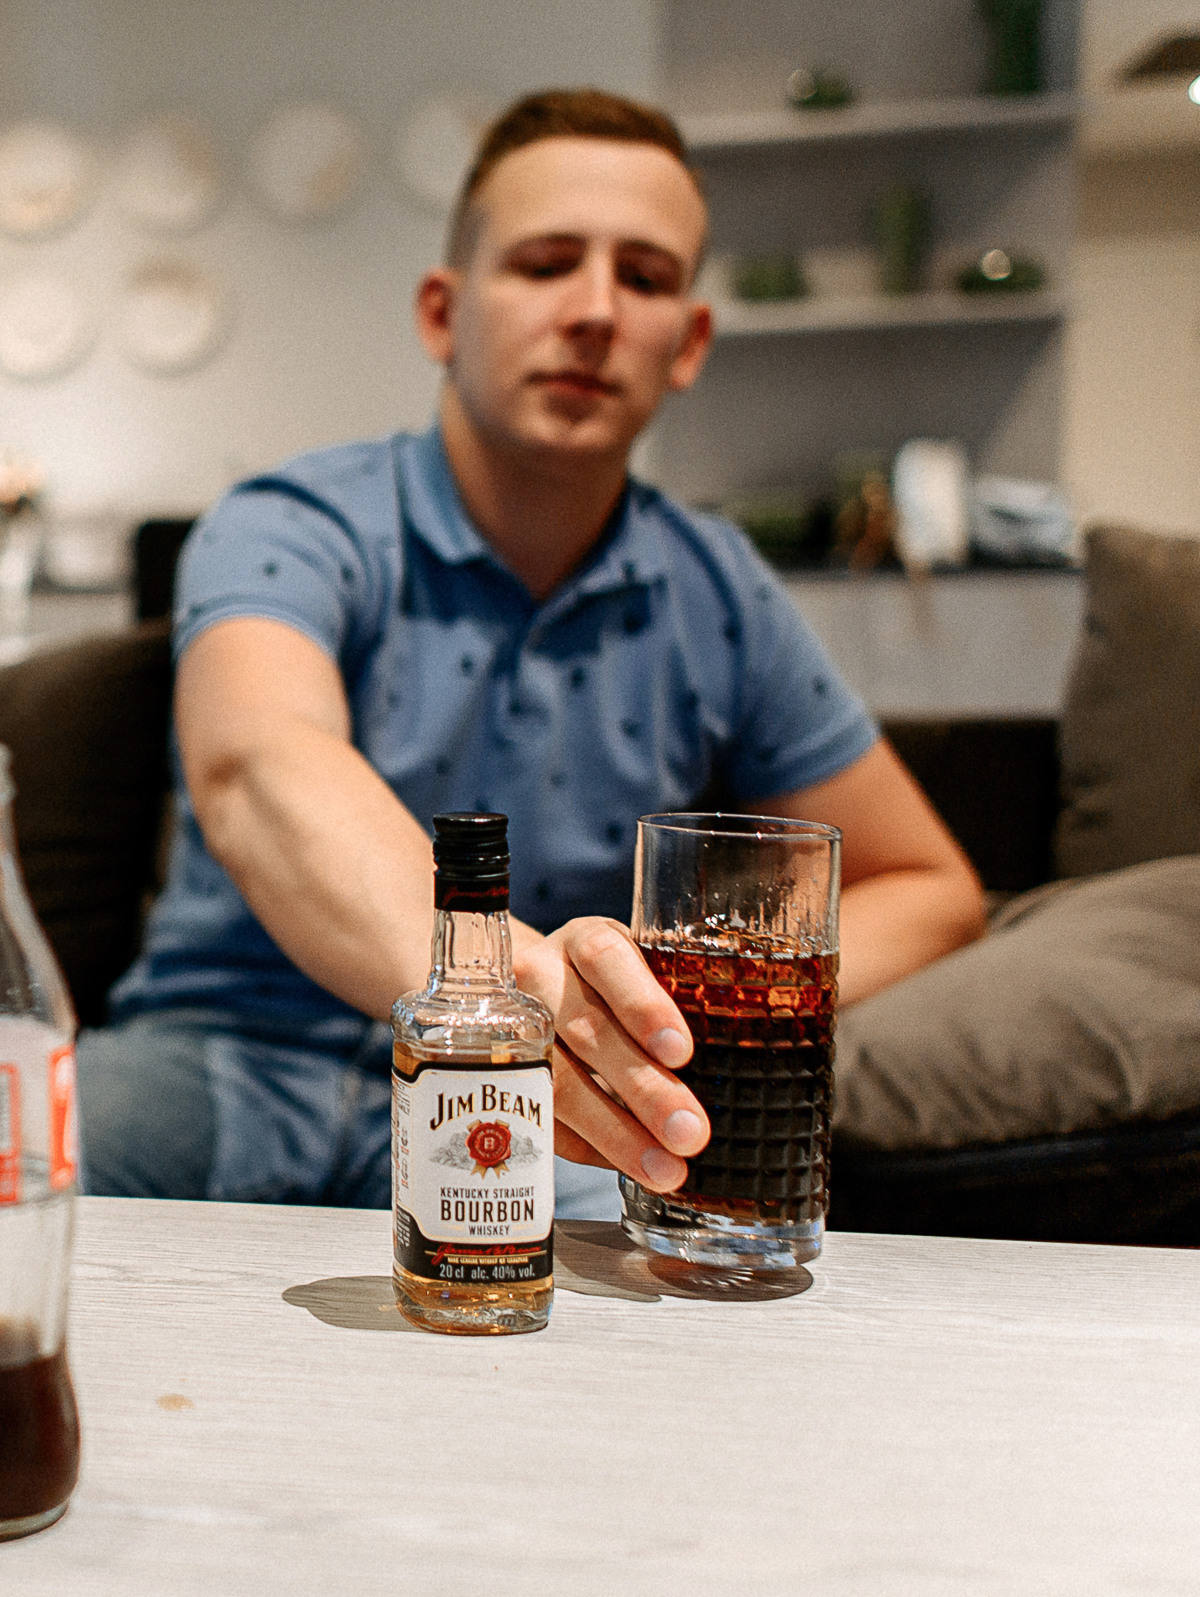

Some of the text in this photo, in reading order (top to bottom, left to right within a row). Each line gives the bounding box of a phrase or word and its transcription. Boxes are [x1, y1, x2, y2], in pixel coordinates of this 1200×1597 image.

[430, 1084, 542, 1130] JIM BEAM
[440, 1186, 535, 1199] KENTUCKY STRAIGHT
[440, 1198, 534, 1222] BOURBON
[468, 1225, 510, 1236] WHISKEY
[439, 1264, 535, 1279] 20 cl alc. 40% vol.
